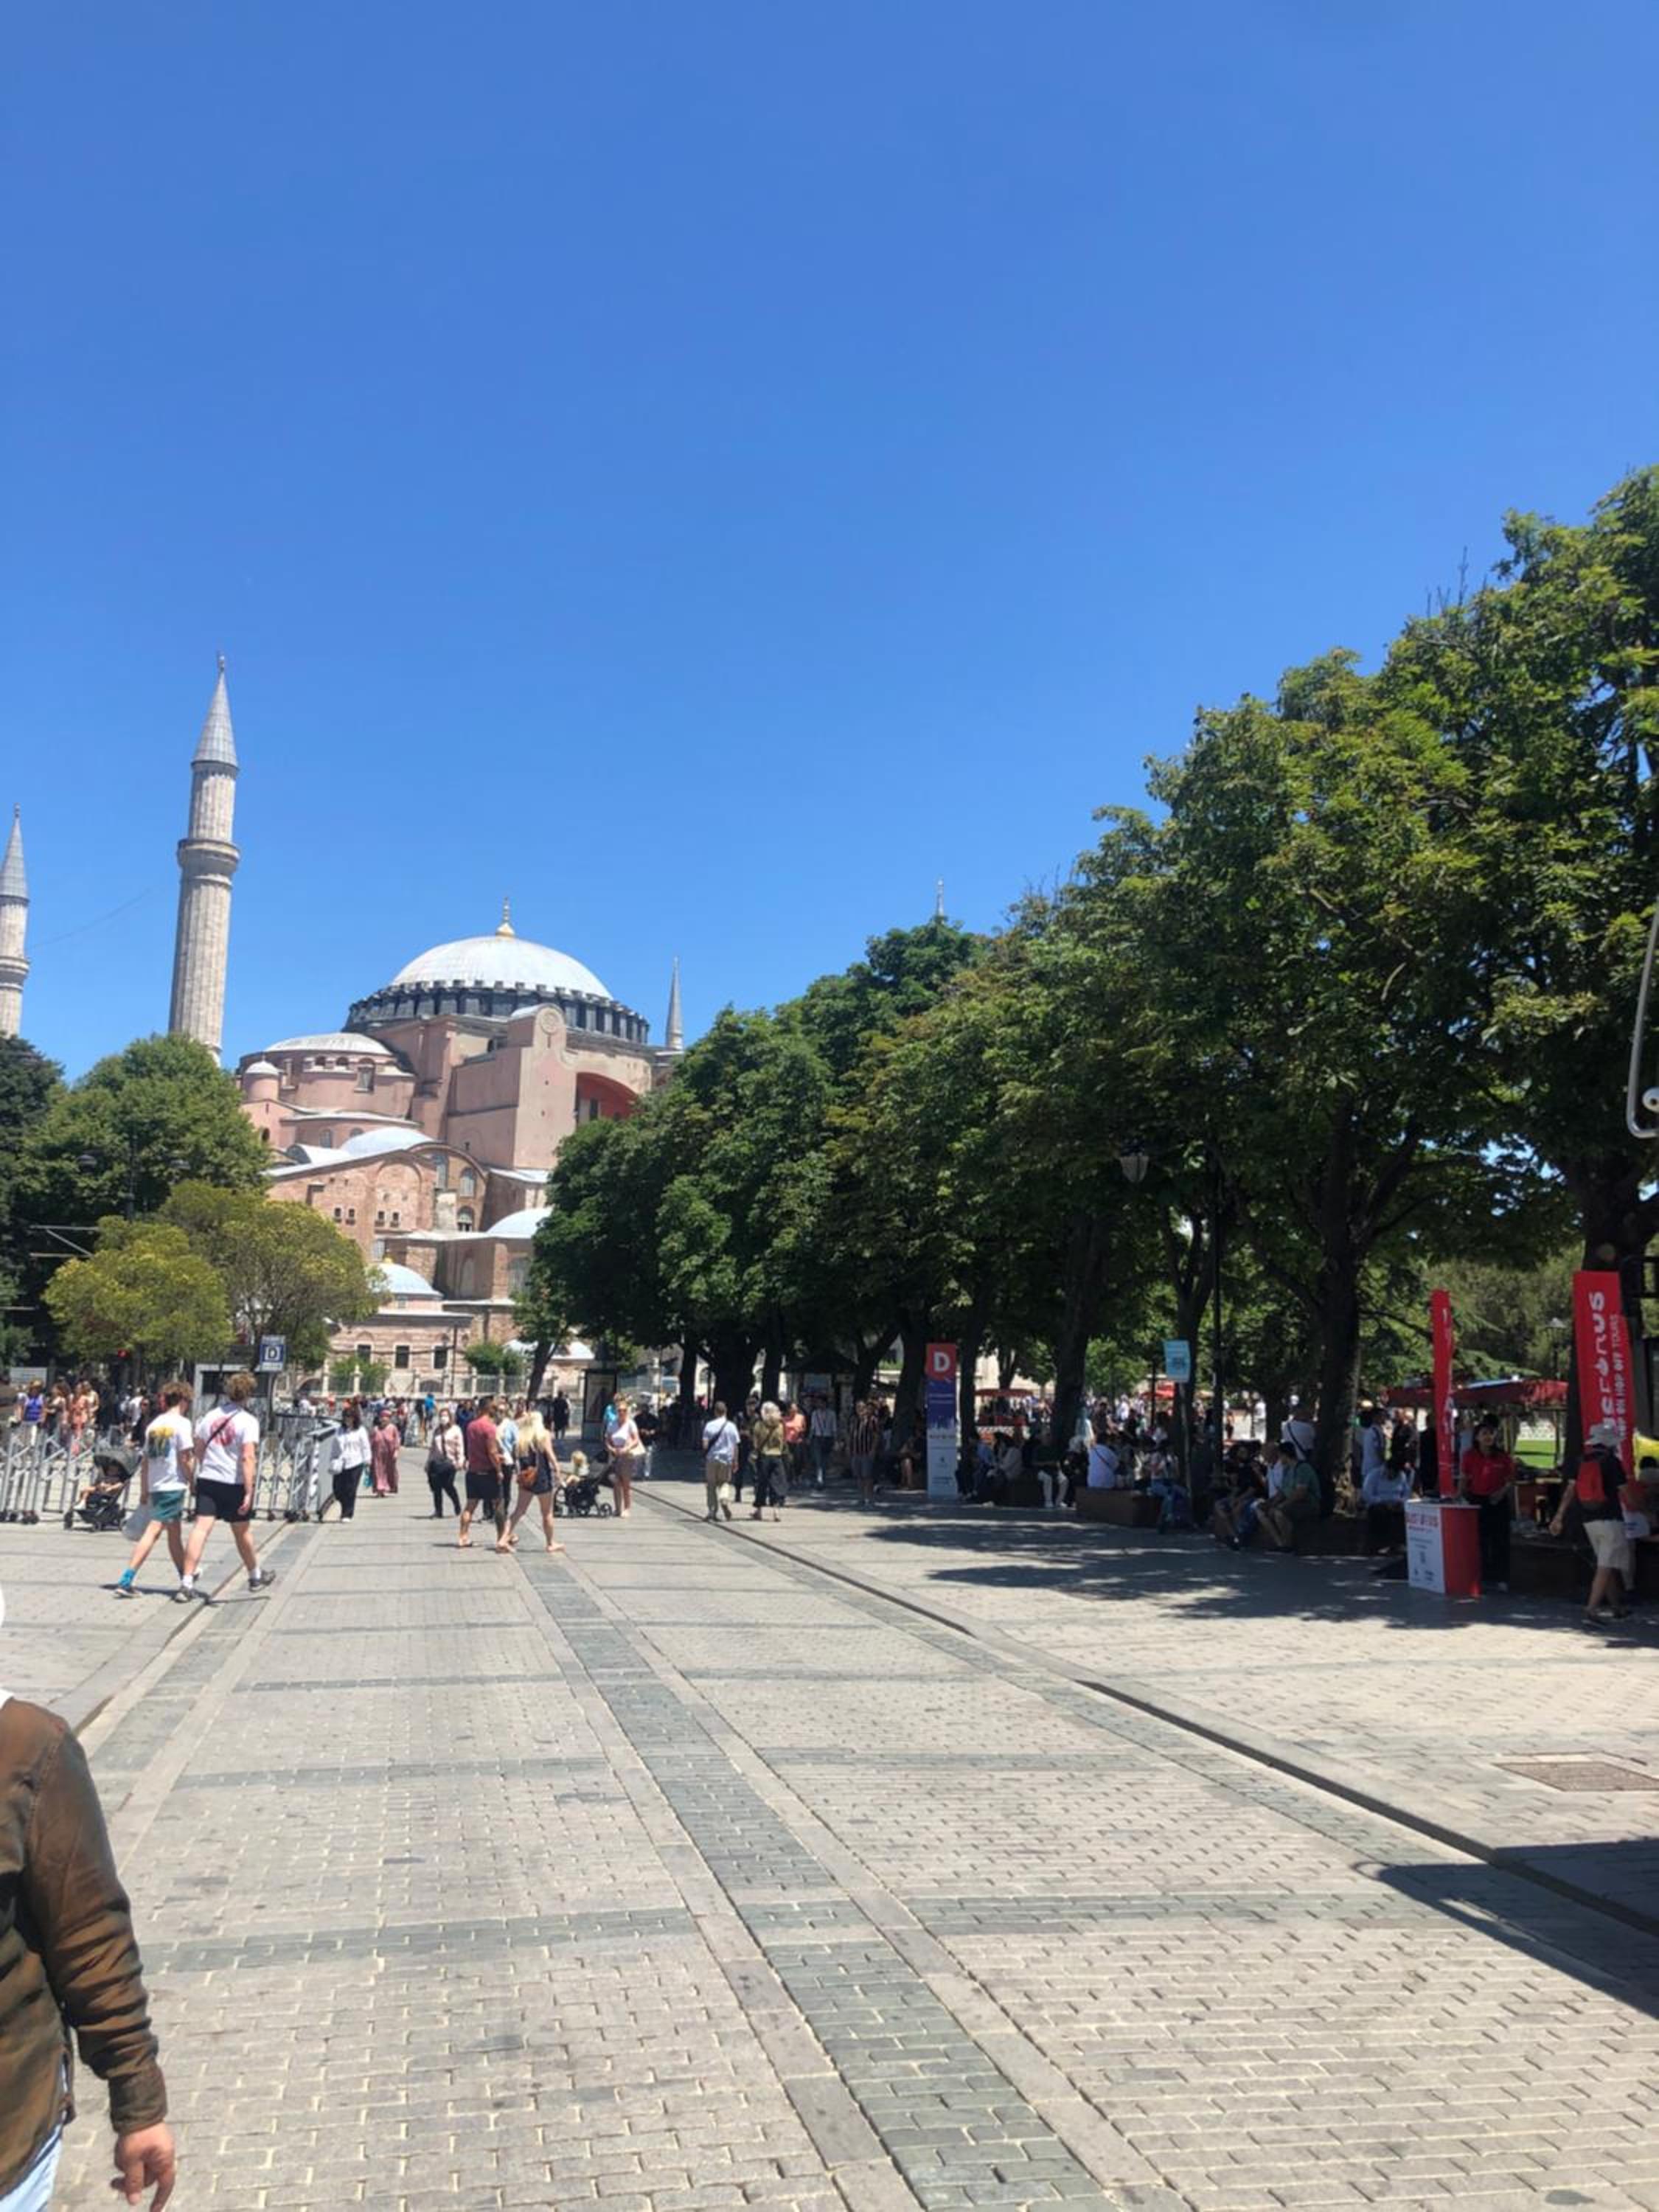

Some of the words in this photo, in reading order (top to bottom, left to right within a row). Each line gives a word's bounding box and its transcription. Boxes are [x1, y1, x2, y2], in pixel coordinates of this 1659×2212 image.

[268, 1347, 277, 1358] D
[933, 1351, 950, 1371] D
[1613, 1351, 1624, 1370] OFF
[1615, 1373, 1626, 1398] HOP
